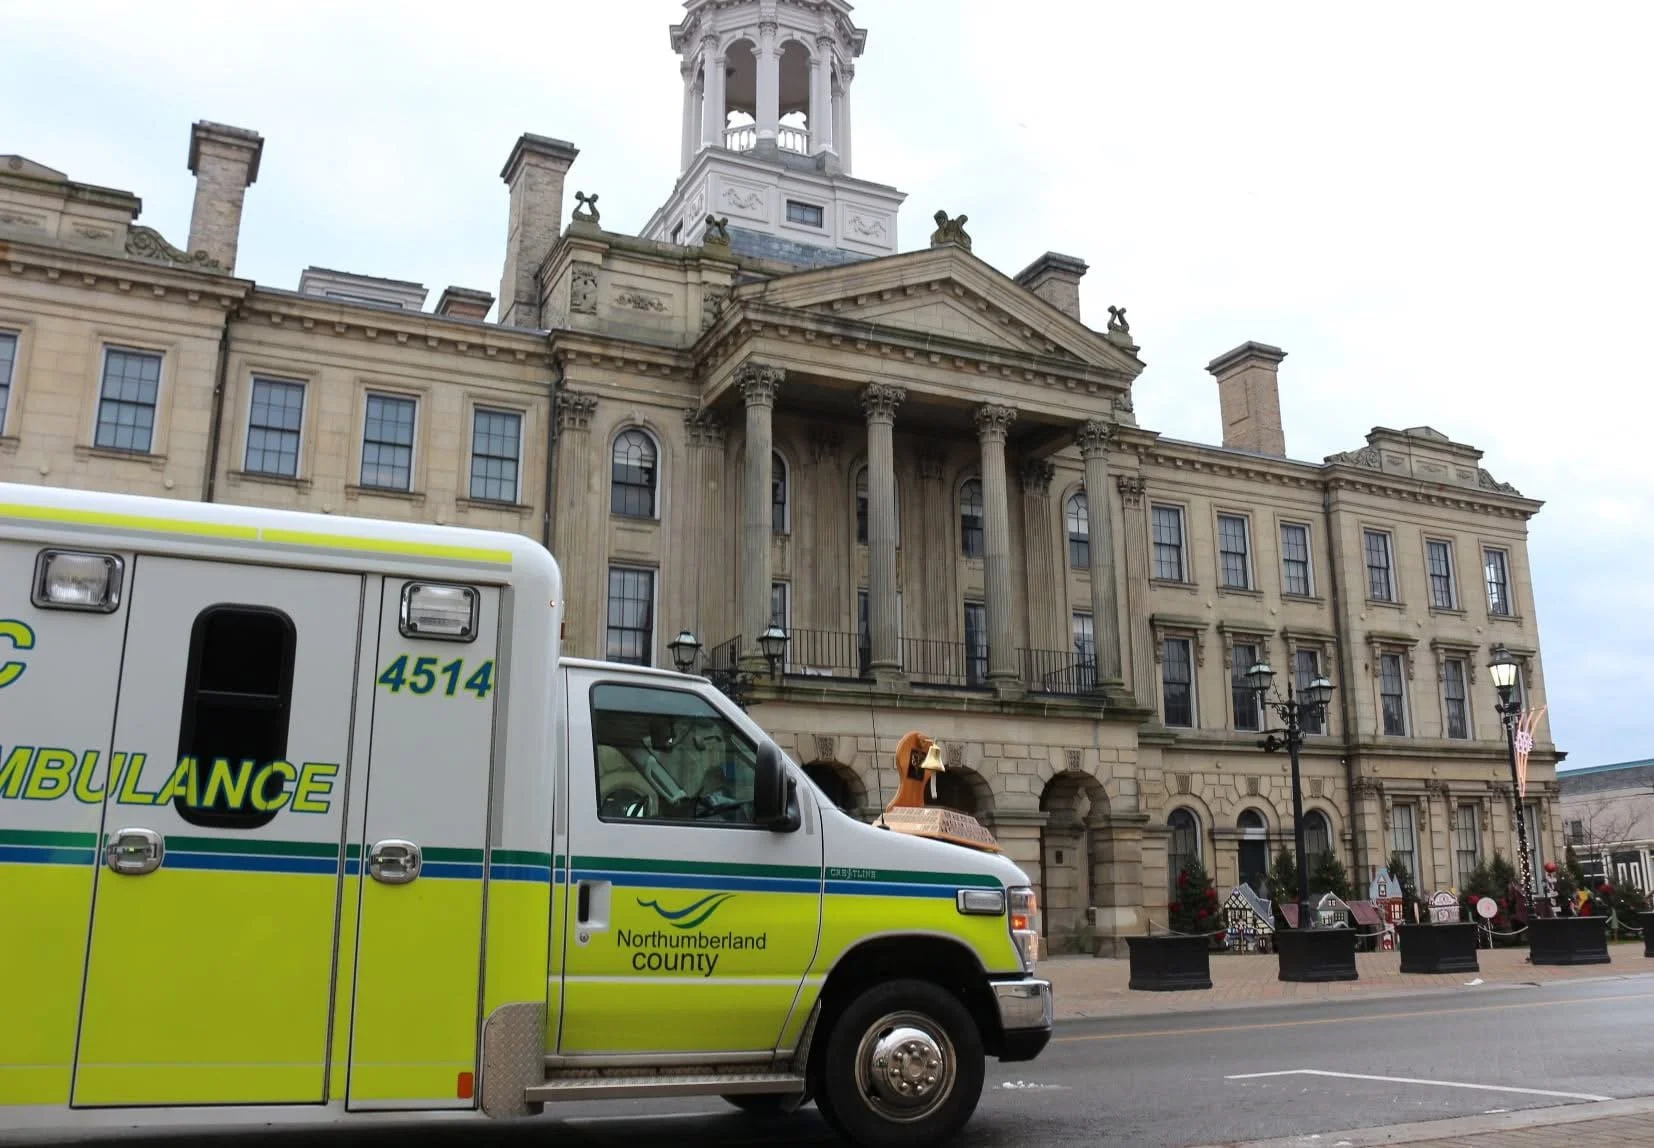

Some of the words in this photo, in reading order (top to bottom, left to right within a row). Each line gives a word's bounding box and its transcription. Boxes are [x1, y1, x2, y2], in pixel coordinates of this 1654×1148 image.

[378, 654, 495, 697] 4514
[616, 929, 767, 950] Northumberland
[632, 952, 719, 977] county
